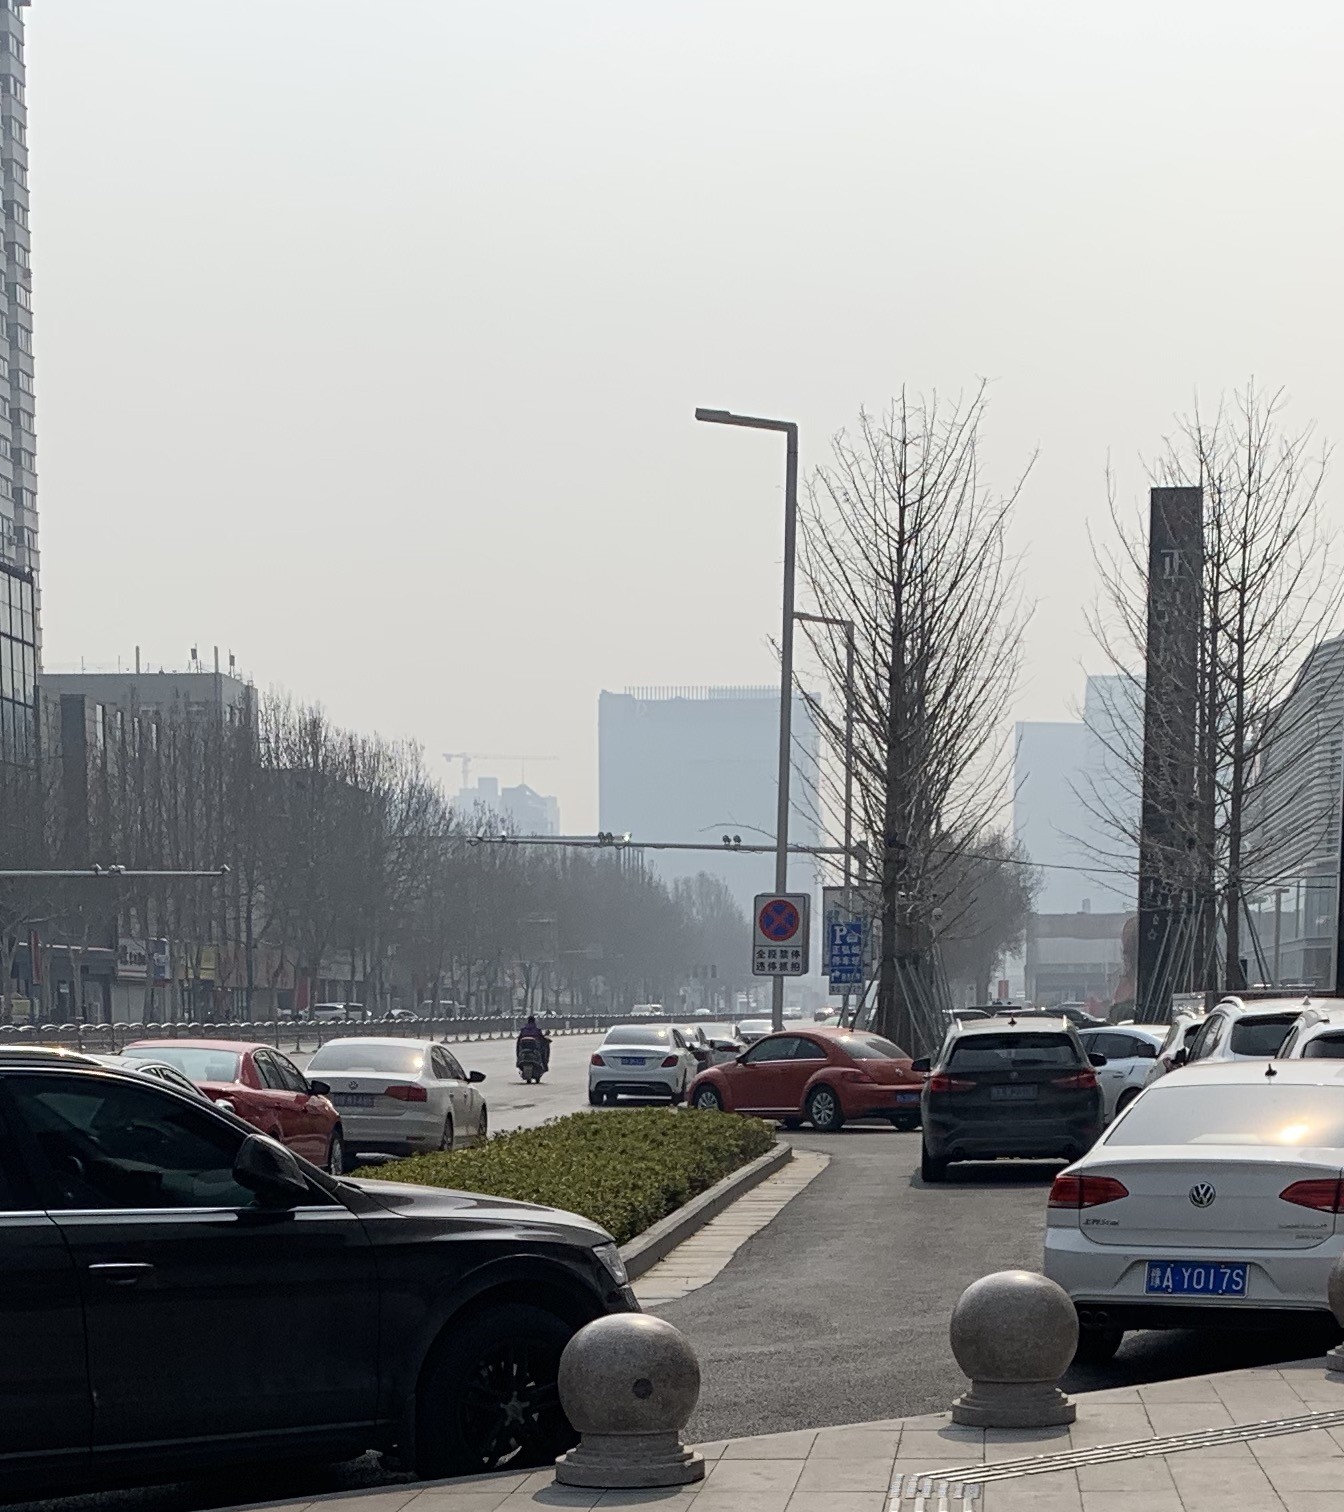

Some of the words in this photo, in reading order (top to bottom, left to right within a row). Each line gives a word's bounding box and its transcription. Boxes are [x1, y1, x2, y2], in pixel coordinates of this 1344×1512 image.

[834, 925, 847, 944] P
[756, 949, 800, 959] 全段禁停
[756, 961, 800, 971] 违停抓拍
